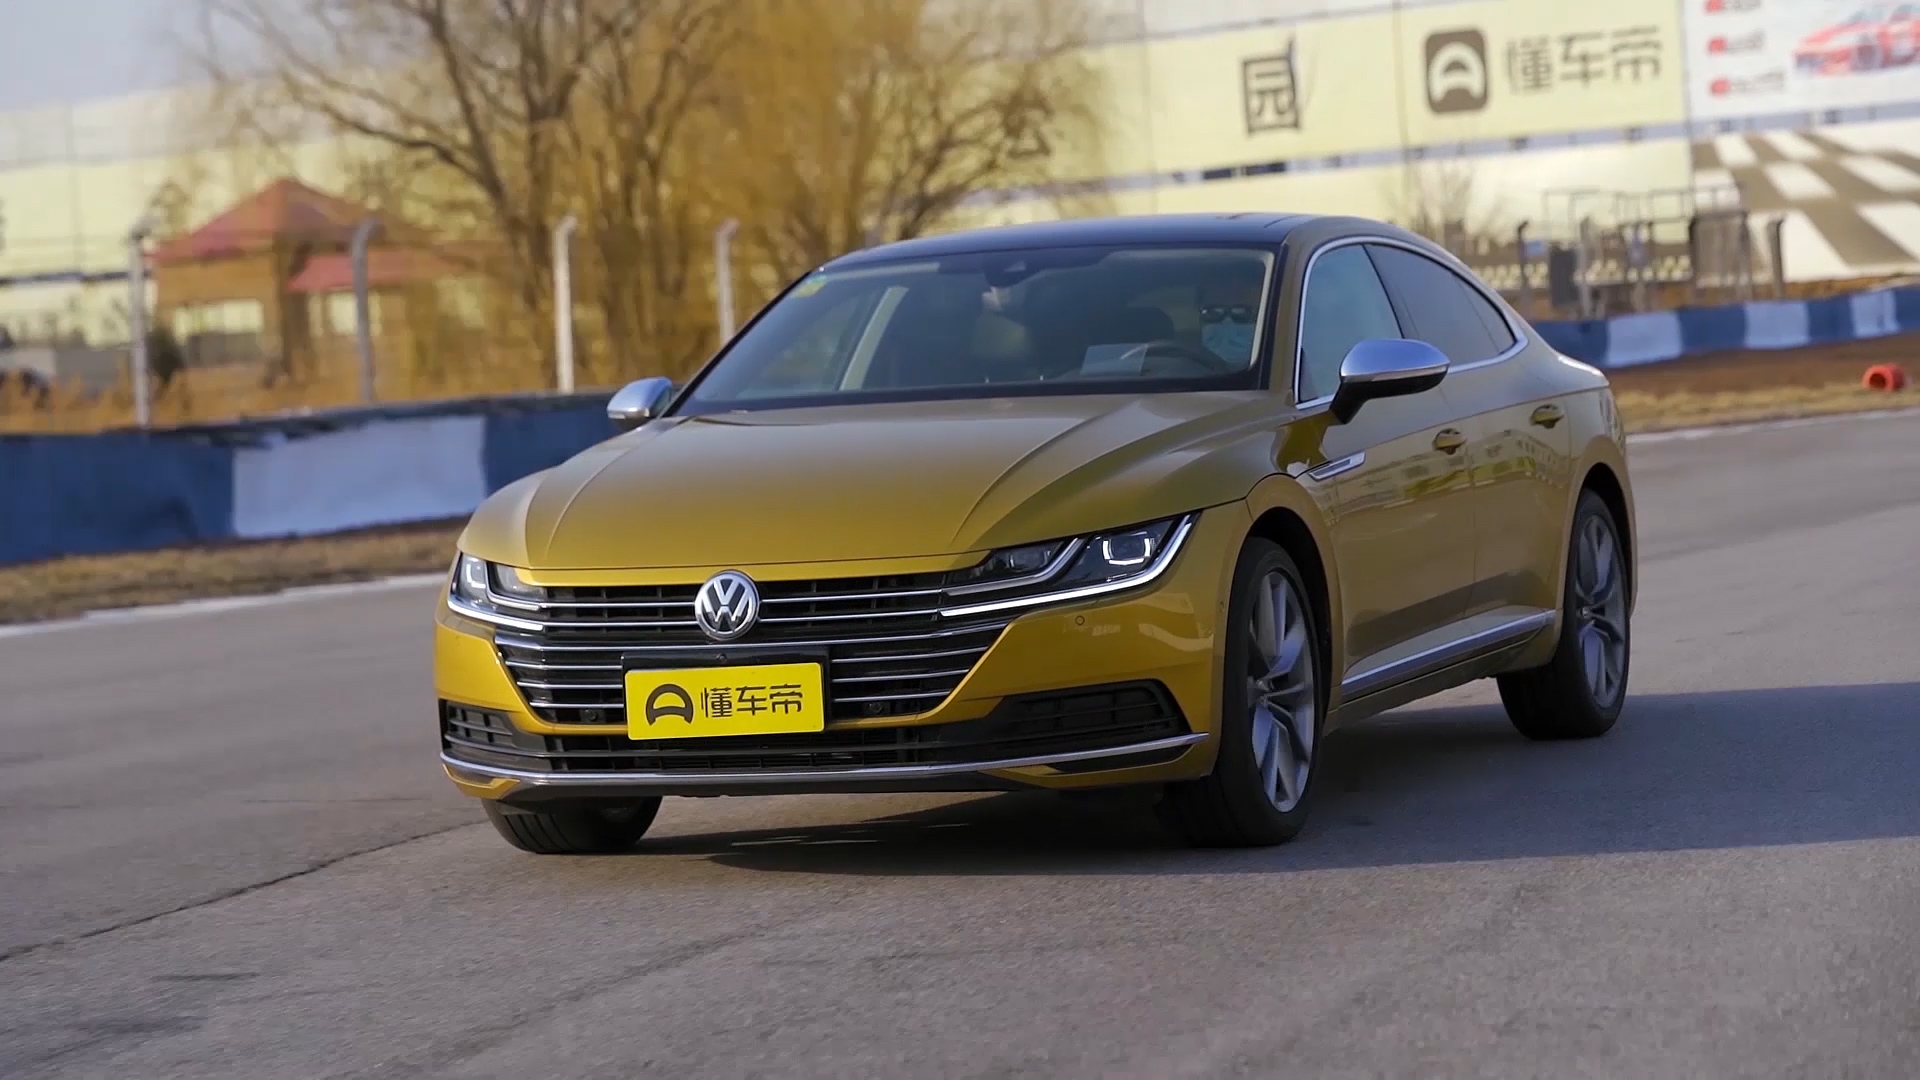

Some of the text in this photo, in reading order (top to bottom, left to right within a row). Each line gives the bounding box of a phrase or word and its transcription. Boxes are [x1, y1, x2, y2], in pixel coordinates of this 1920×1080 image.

[1505, 25, 1663, 95] 懂车帝
[700, 683, 803, 719] 懂车帝
